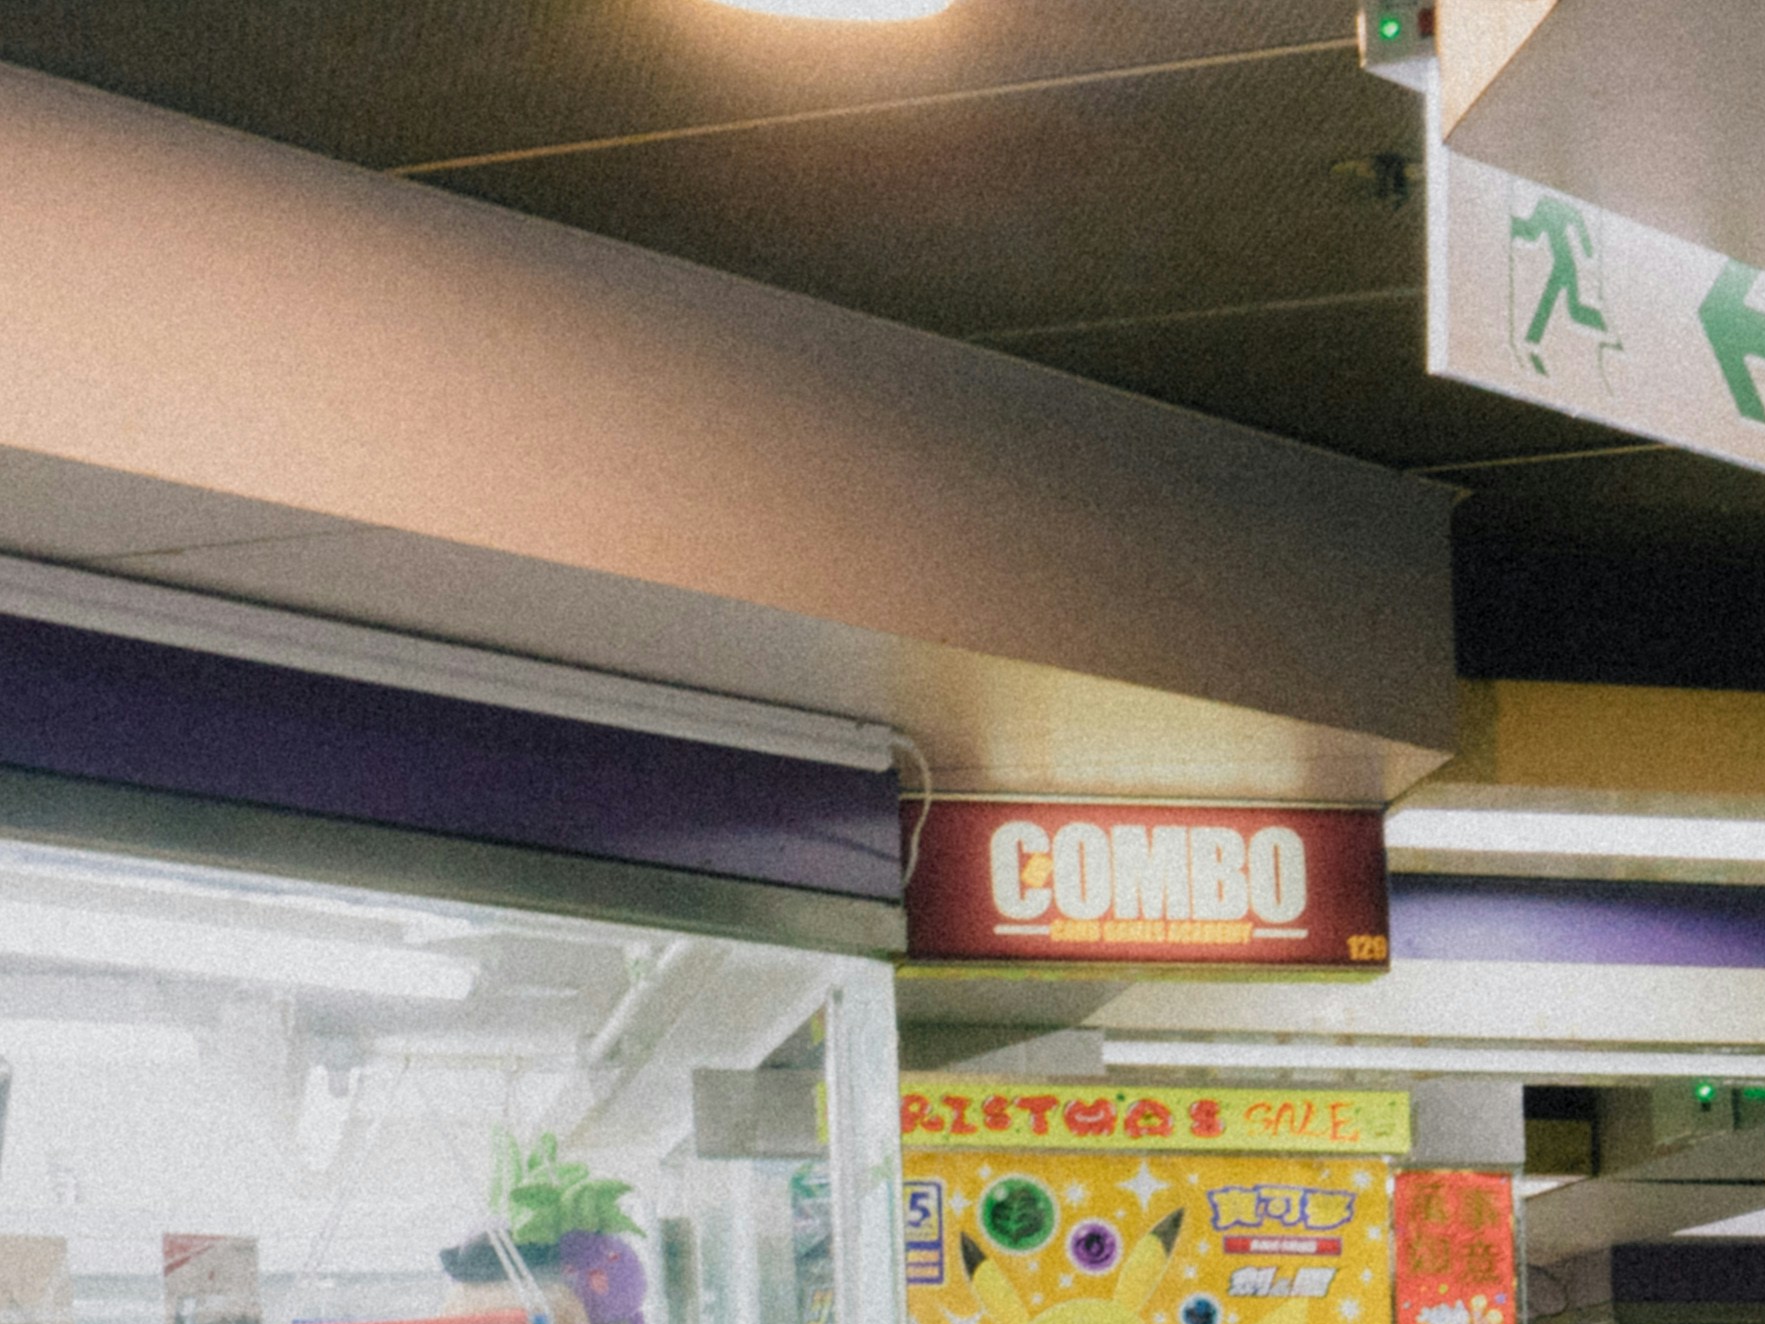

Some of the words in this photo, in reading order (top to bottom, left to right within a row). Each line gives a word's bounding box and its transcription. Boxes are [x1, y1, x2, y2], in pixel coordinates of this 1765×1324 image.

[989, 820, 1308, 922] COMBO
[1347, 935, 1387, 961] 129
[1243, 1101, 1359, 1142] SALE
